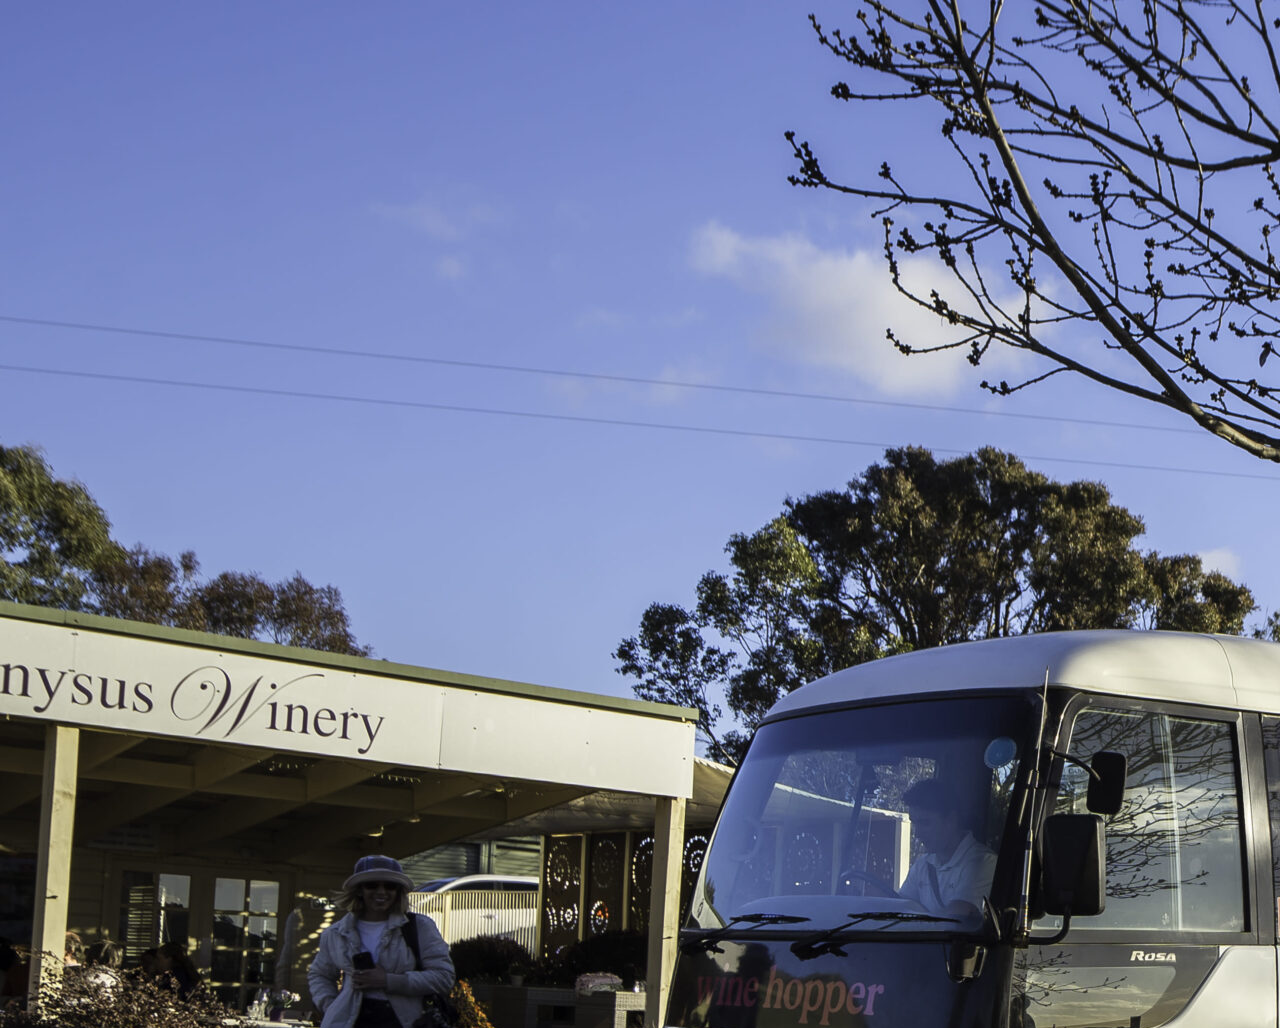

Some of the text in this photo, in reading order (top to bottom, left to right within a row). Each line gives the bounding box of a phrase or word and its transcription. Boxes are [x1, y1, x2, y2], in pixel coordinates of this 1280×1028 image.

[0, 662, 385, 755] nysus Winery
[762, 964, 885, 1026] hopper
